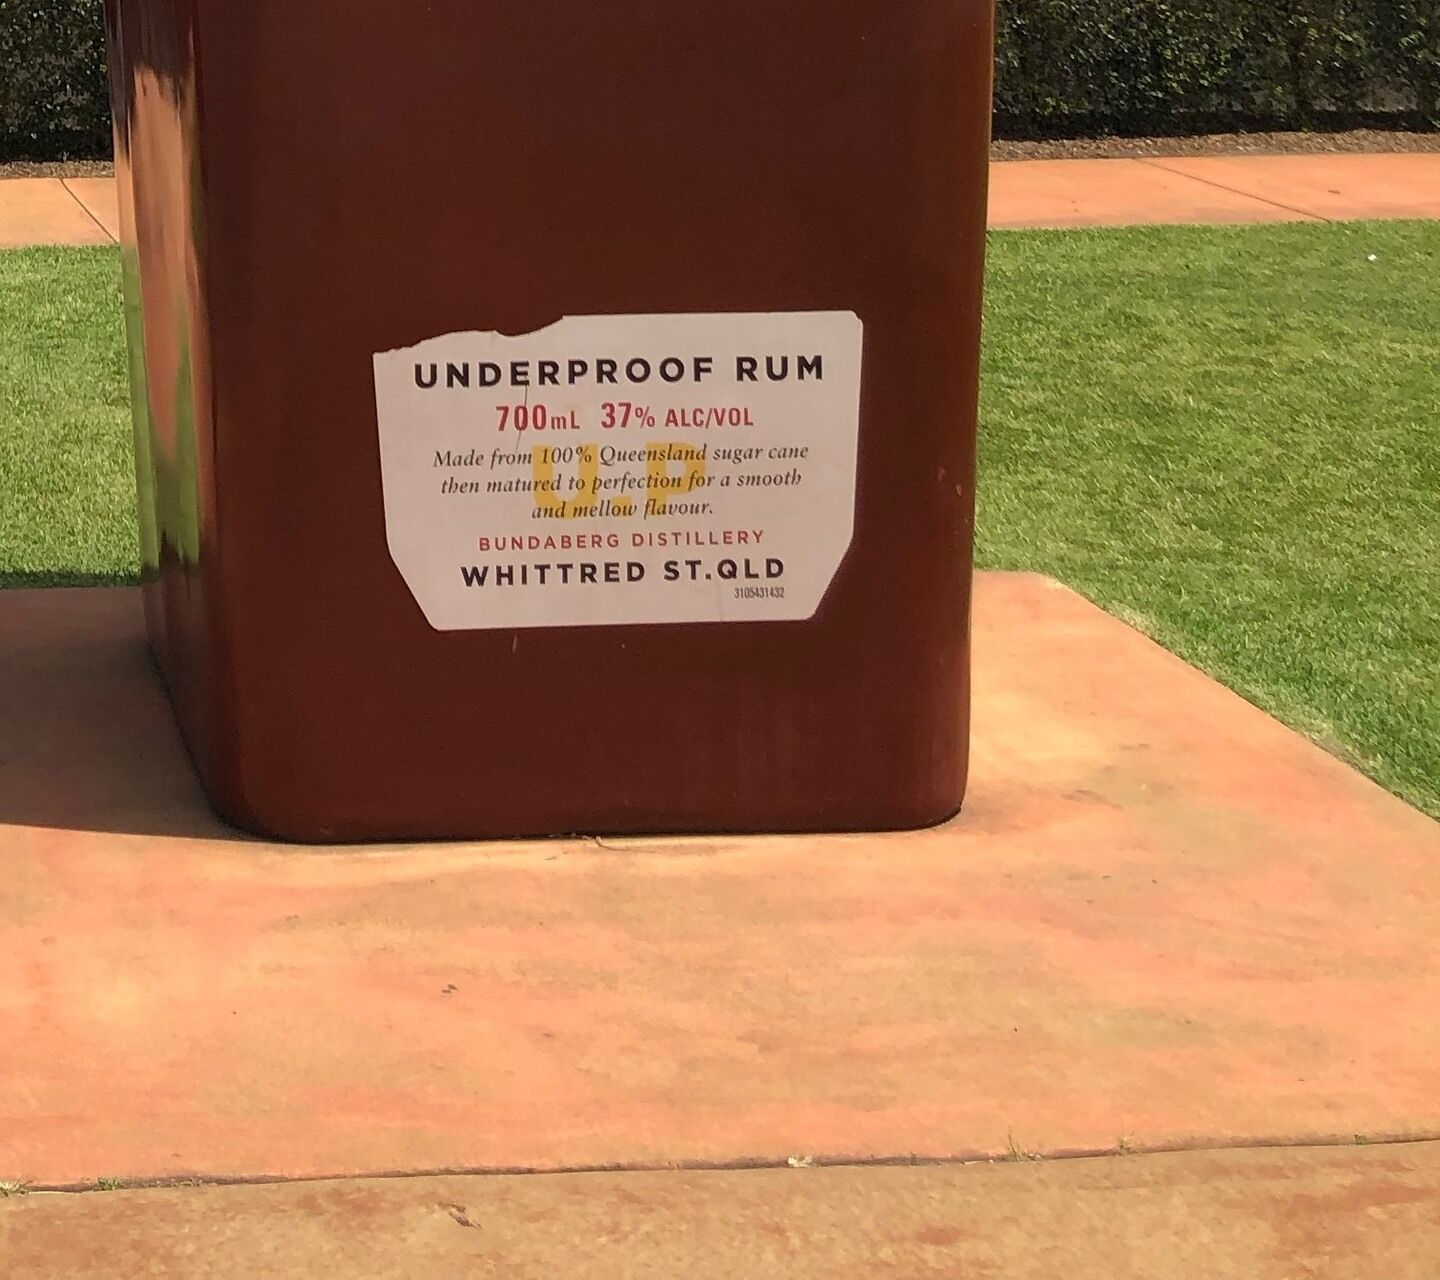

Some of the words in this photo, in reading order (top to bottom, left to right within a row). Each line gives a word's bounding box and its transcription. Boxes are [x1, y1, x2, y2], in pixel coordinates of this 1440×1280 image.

[414, 356, 713, 389] UNDERPROOF
[736, 355, 823, 382] RUM
[496, 404, 581, 432] 700mL
[601, 401, 656, 429] 37%
[664, 407, 754, 429] ALC/VOL
[433, 448, 485, 468] Made
[489, 447, 533, 471] from
[541, 446, 592, 465] 100%
[599, 443, 708, 467] Queensland
[712, 446, 764, 465] sugar
[767, 445, 809, 460] cane
[441, 476, 480, 495] then
[486, 473, 562, 493] matured
[568, 475, 586, 491] to
[591, 471, 682, 495] perfection
[687, 470, 716, 492] for
[719, 475, 731, 487] a
[736, 468, 802, 487] smooth
[531, 500, 567, 519] and
[572, 499, 638, 518] mellow
[643, 498, 713, 520] flavour.
[479, 534, 620, 552] BUNDABERG
[631, 530, 765, 548] DISTILLERY
[460, 561, 646, 588] WHITTRED
[663, 558, 785, 581] ST.QLD
